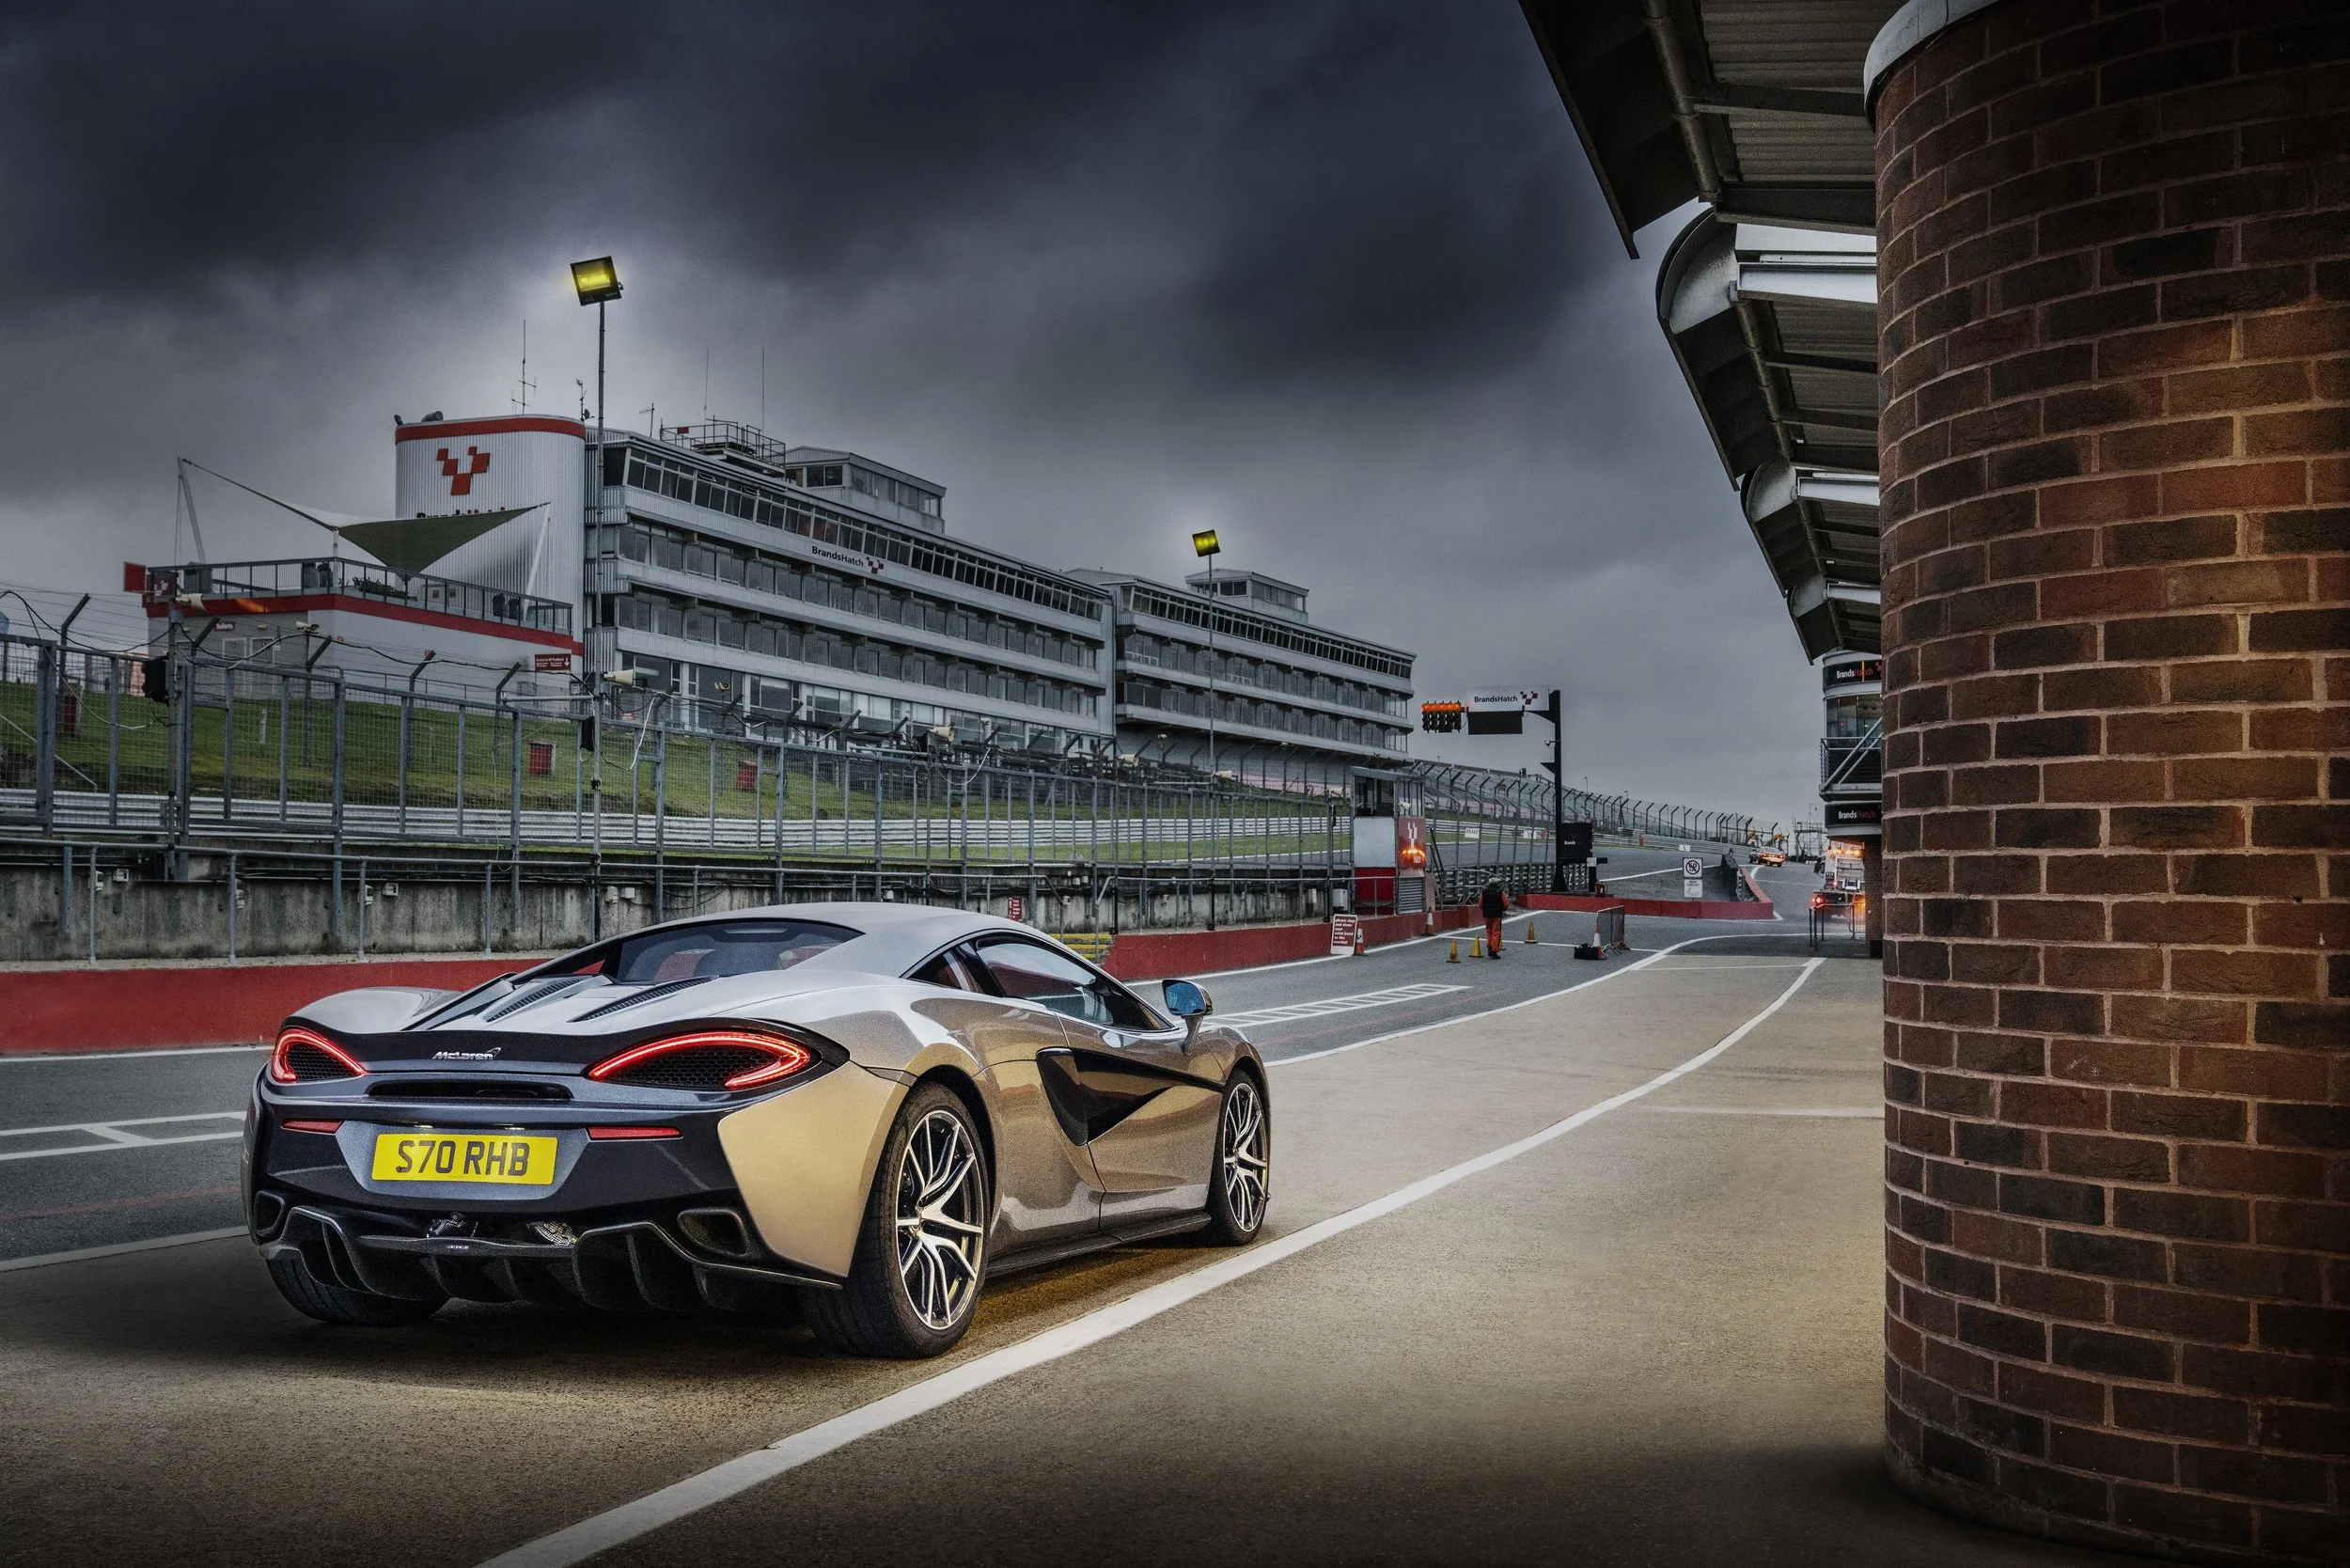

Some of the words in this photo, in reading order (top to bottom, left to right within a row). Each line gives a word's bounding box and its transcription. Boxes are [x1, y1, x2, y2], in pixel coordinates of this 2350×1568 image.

[811, 545, 864, 568] BrandsHatch
[1474, 695, 1518, 703] BrandsHatch
[431, 1051, 494, 1060] McLaren
[396, 1139, 457, 1174] S70
[463, 1140, 531, 1177] RHB
